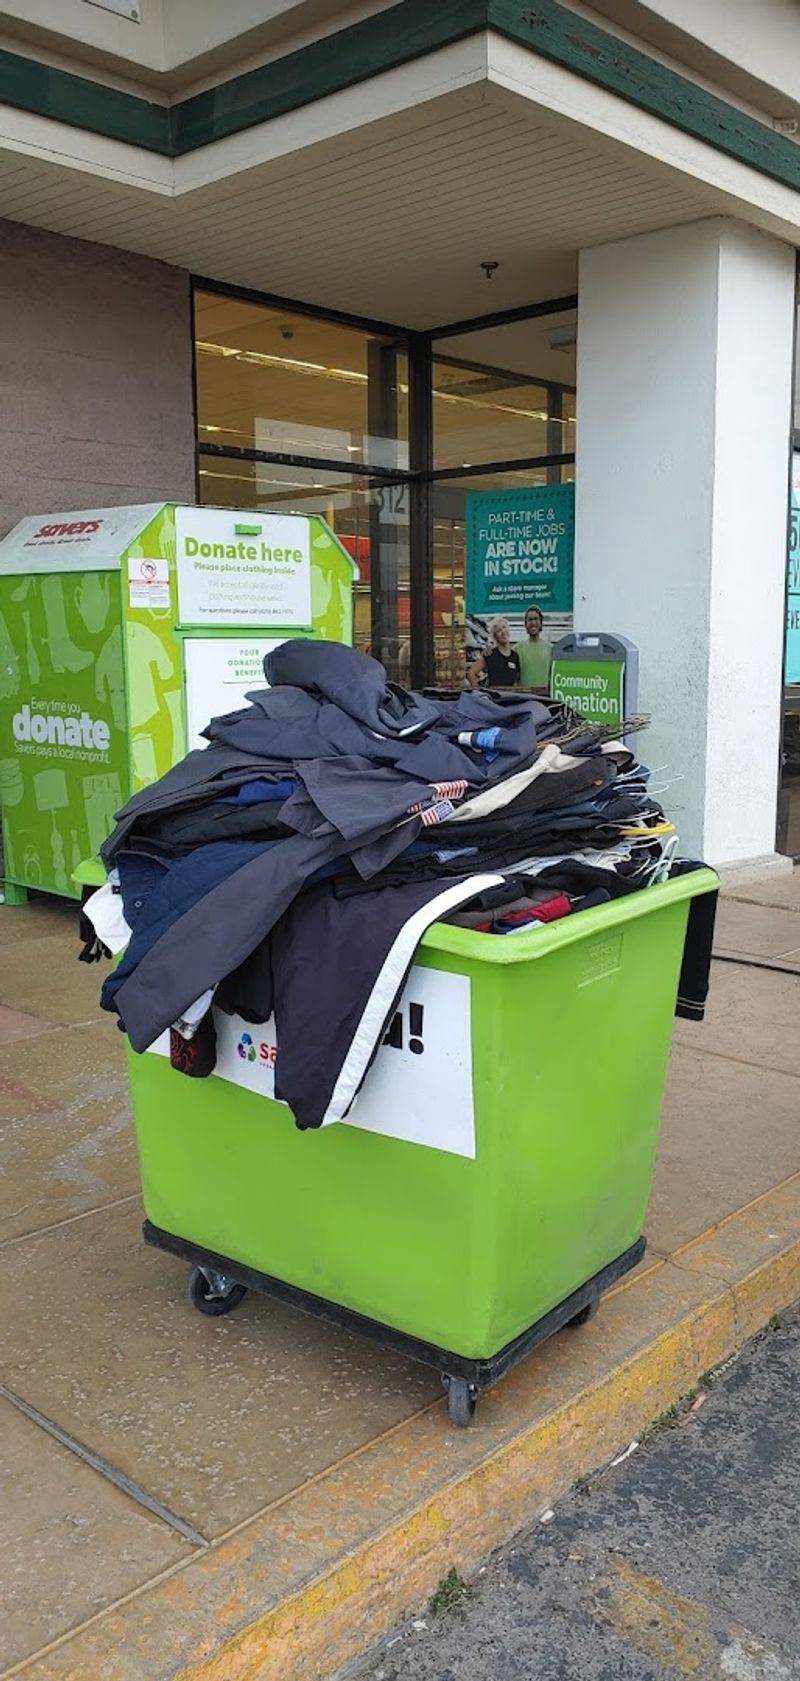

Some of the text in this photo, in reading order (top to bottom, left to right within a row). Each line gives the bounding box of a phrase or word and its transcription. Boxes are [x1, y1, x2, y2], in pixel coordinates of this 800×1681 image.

[488, 508, 555, 525] PART-TIME &
[479, 522, 565, 541] FULL-TIME JOBS
[184, 537, 303, 563] Donate here
[485, 537, 558, 559] ARE NOW
[194, 562, 219, 571] Please
[220, 563, 241, 574] place
[243, 565, 273, 575] clothing
[484, 556, 558, 577] IN STOCK!
[554, 674, 608, 692] Community
[31, 697, 81, 715] Every time you
[12, 704, 110, 751] donate
